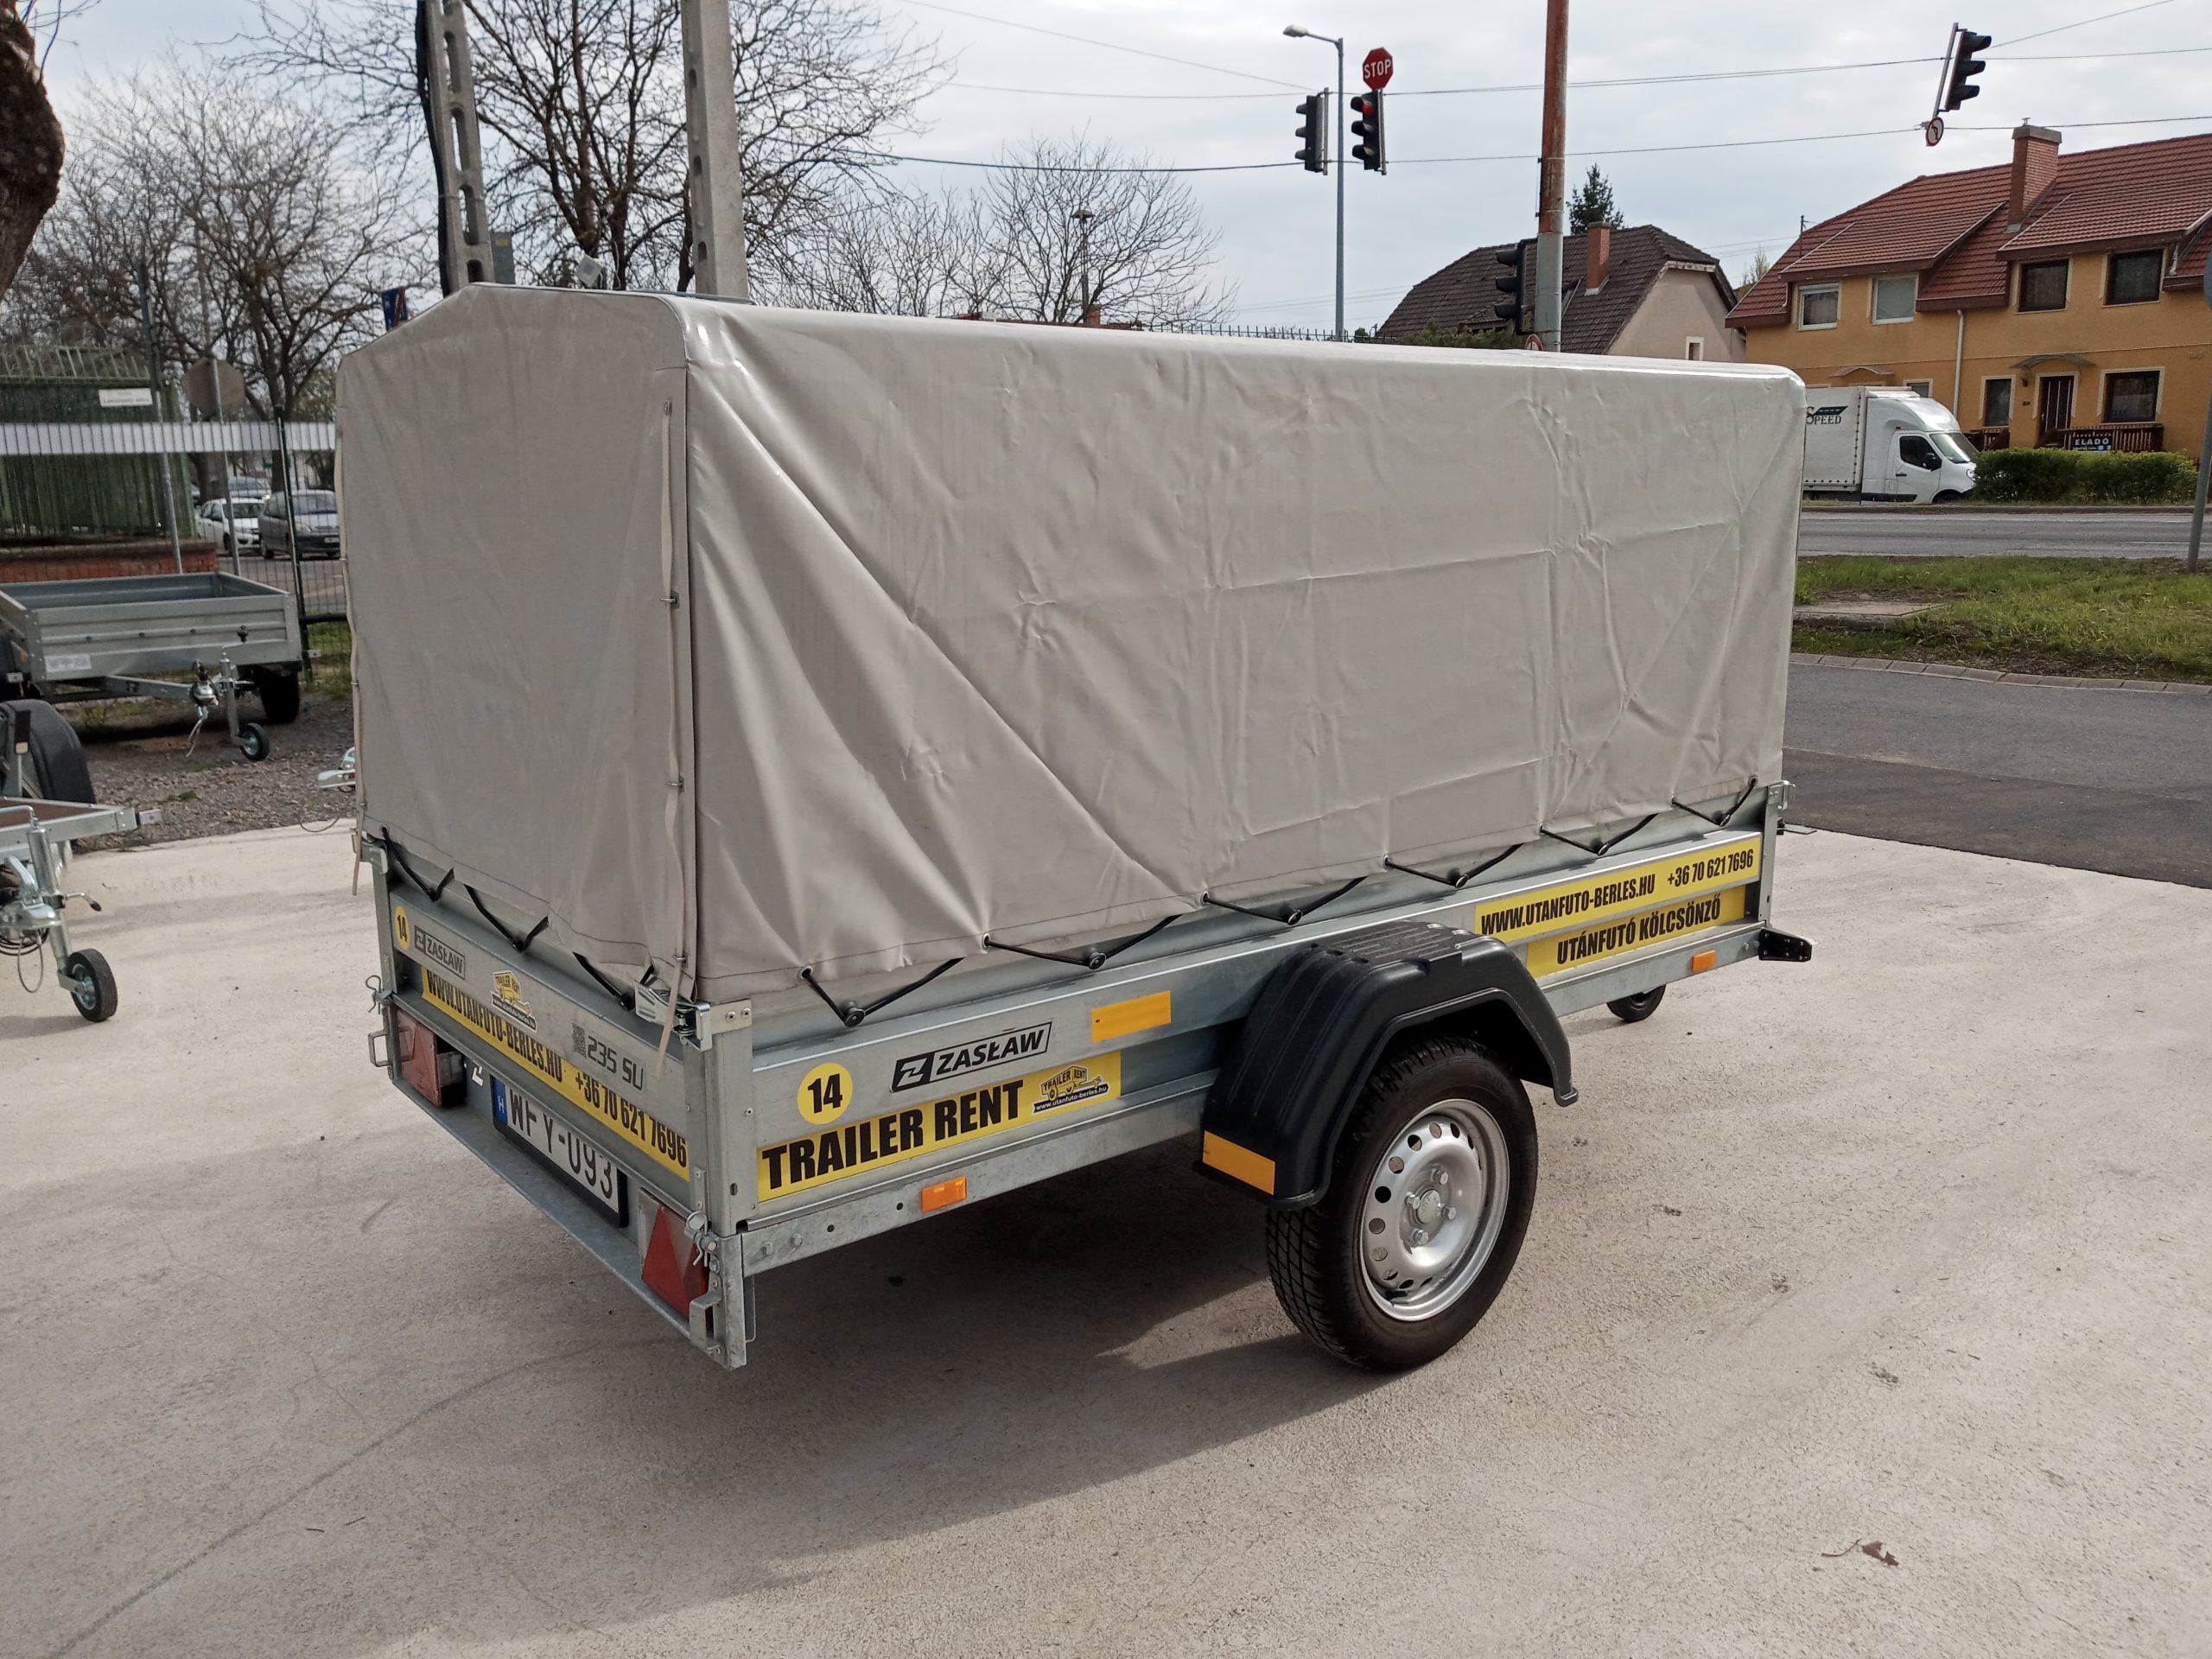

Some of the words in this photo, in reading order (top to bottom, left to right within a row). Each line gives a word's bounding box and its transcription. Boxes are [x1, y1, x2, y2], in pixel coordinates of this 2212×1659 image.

[1363, 59, 1392, 79] STOP
[2075, 437, 2109, 446] ELADÓ
[1481, 874, 1655, 935] WWW.UTANFUTO-BERLES.HU
[1668, 865, 1689, 887] +36
[1692, 861, 1705, 882] 70
[1707, 855, 1726, 878] 621
[1727, 849, 1753, 873] 7696
[397, 914, 408, 942] 14
[1557, 918, 1636, 964] UTÁNFUTÓ
[1639, 893, 1721, 941] KÖLCSÖNZŐ
[427, 938, 463, 974] ZASŁAW
[588, 1035, 617, 1074] 235
[622, 1058, 644, 1090] SU
[936, 1029, 1045, 1076] ZASŁAW
[807, 1073, 843, 1114] 14
[1036, 1086, 1107, 1111] www.utanfuto-berles.hu
[1044, 1071, 1071, 1090] TRAILER
[1074, 1069, 1086, 1079] RENT
[498, 1095, 505, 1114] H
[575, 1071, 600, 1109] +36
[602, 1084, 618, 1121] 70
[620, 1096, 645, 1141] 621
[648, 1116, 687, 1168] 7696
[762, 1109, 924, 1190] TRAILER
[935, 1079, 1023, 1141] RENT
